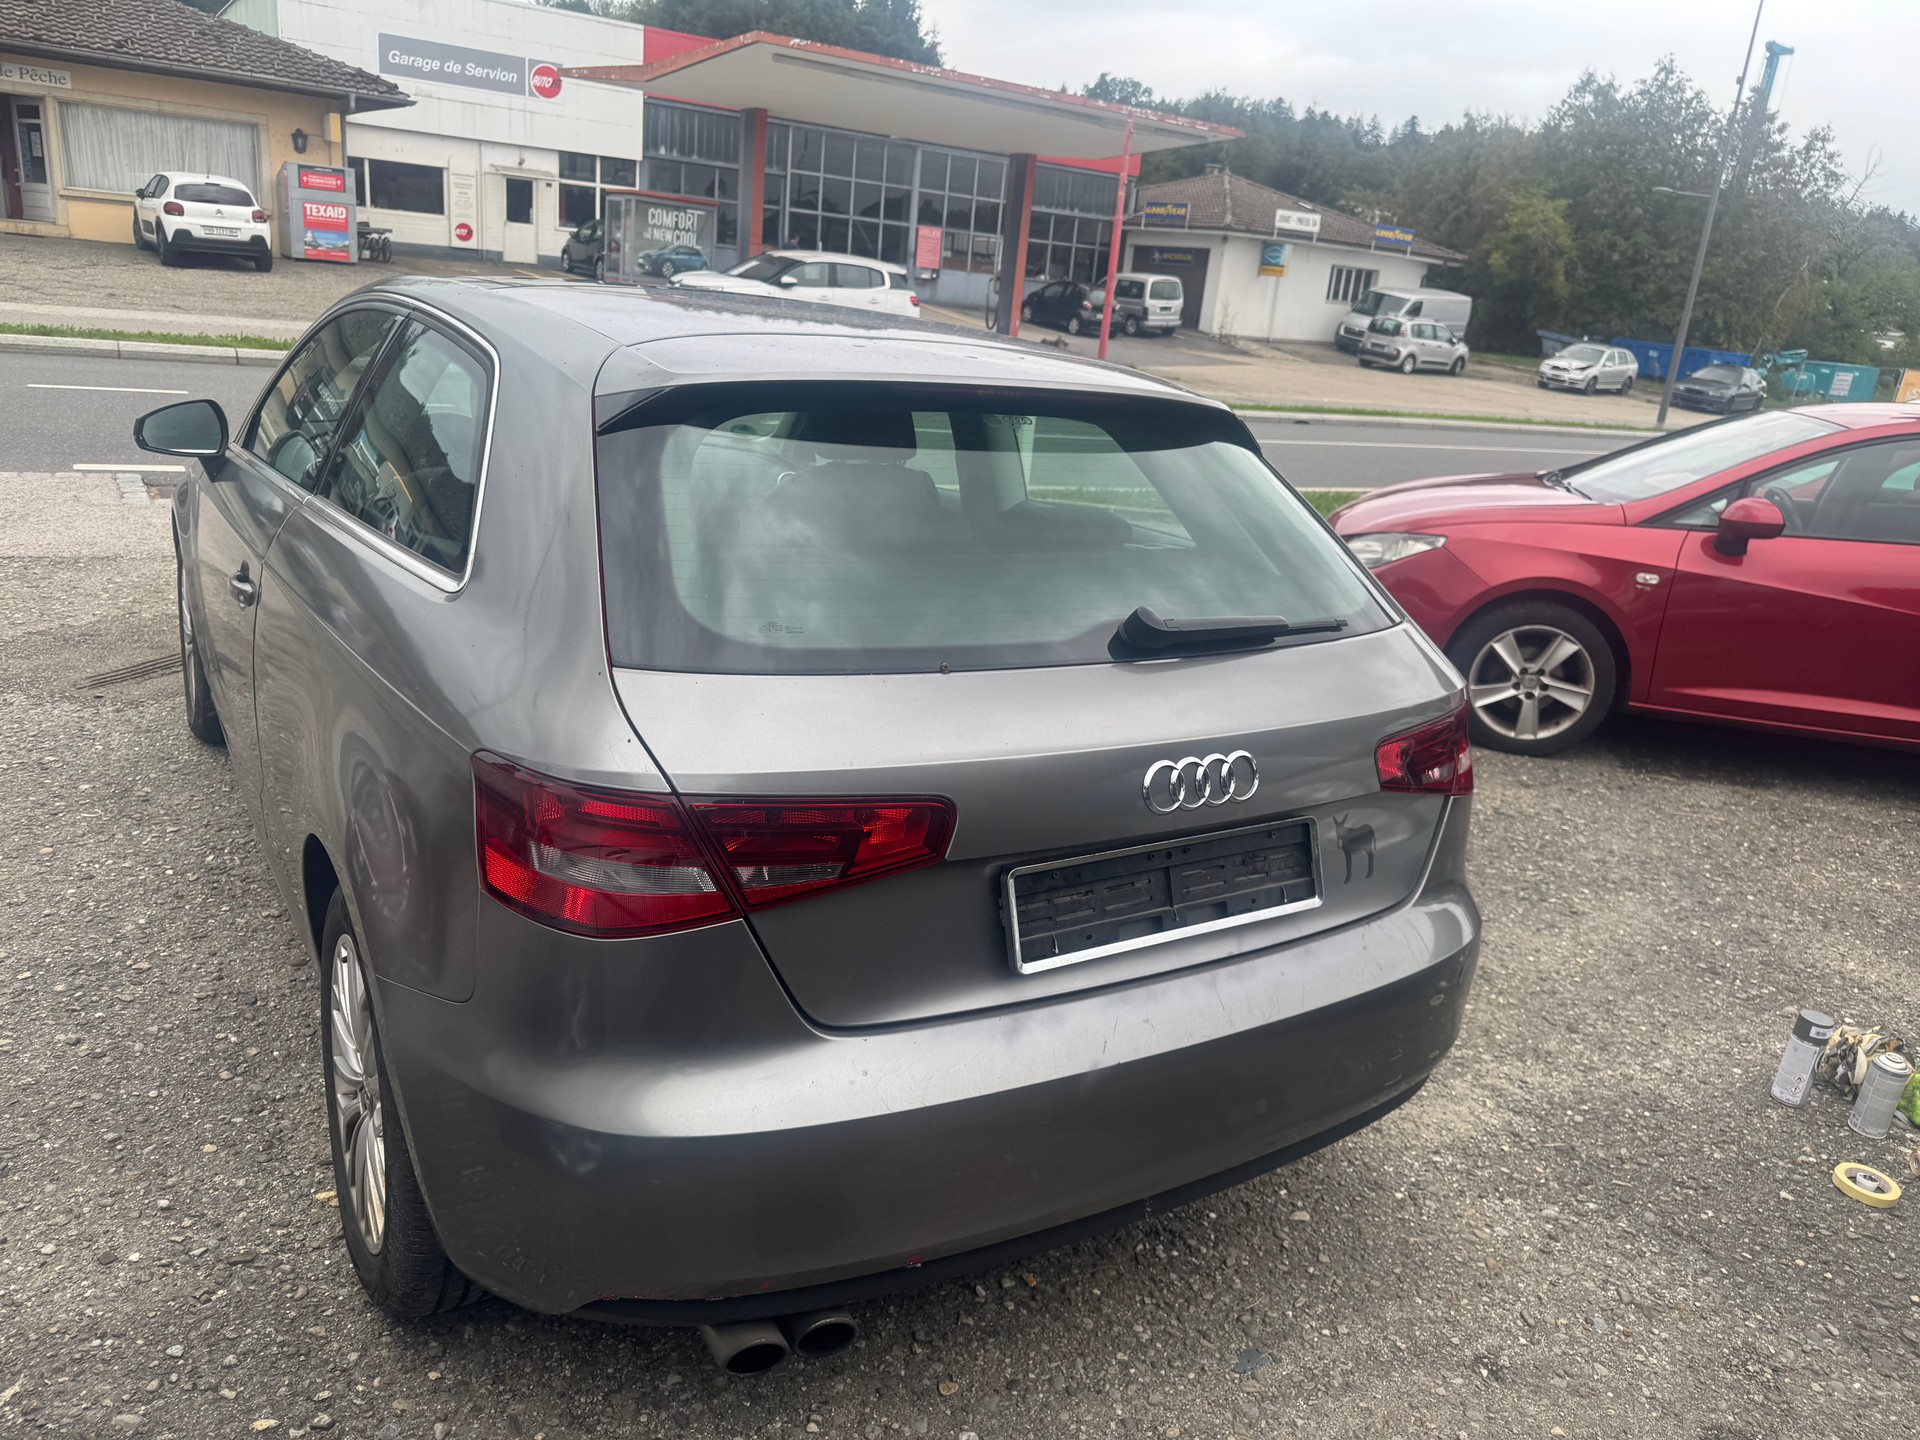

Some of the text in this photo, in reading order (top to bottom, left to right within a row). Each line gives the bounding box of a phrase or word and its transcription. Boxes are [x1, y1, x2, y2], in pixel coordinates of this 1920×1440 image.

[18, 67, 68, 85] Pêche
[388, 50, 518, 83] Garage de Servion
[304, 203, 347, 220] TEXAID
[648, 207, 706, 232] COMFORT
[653, 228, 674, 242] NEW
[673, 229, 703, 249] COOL
